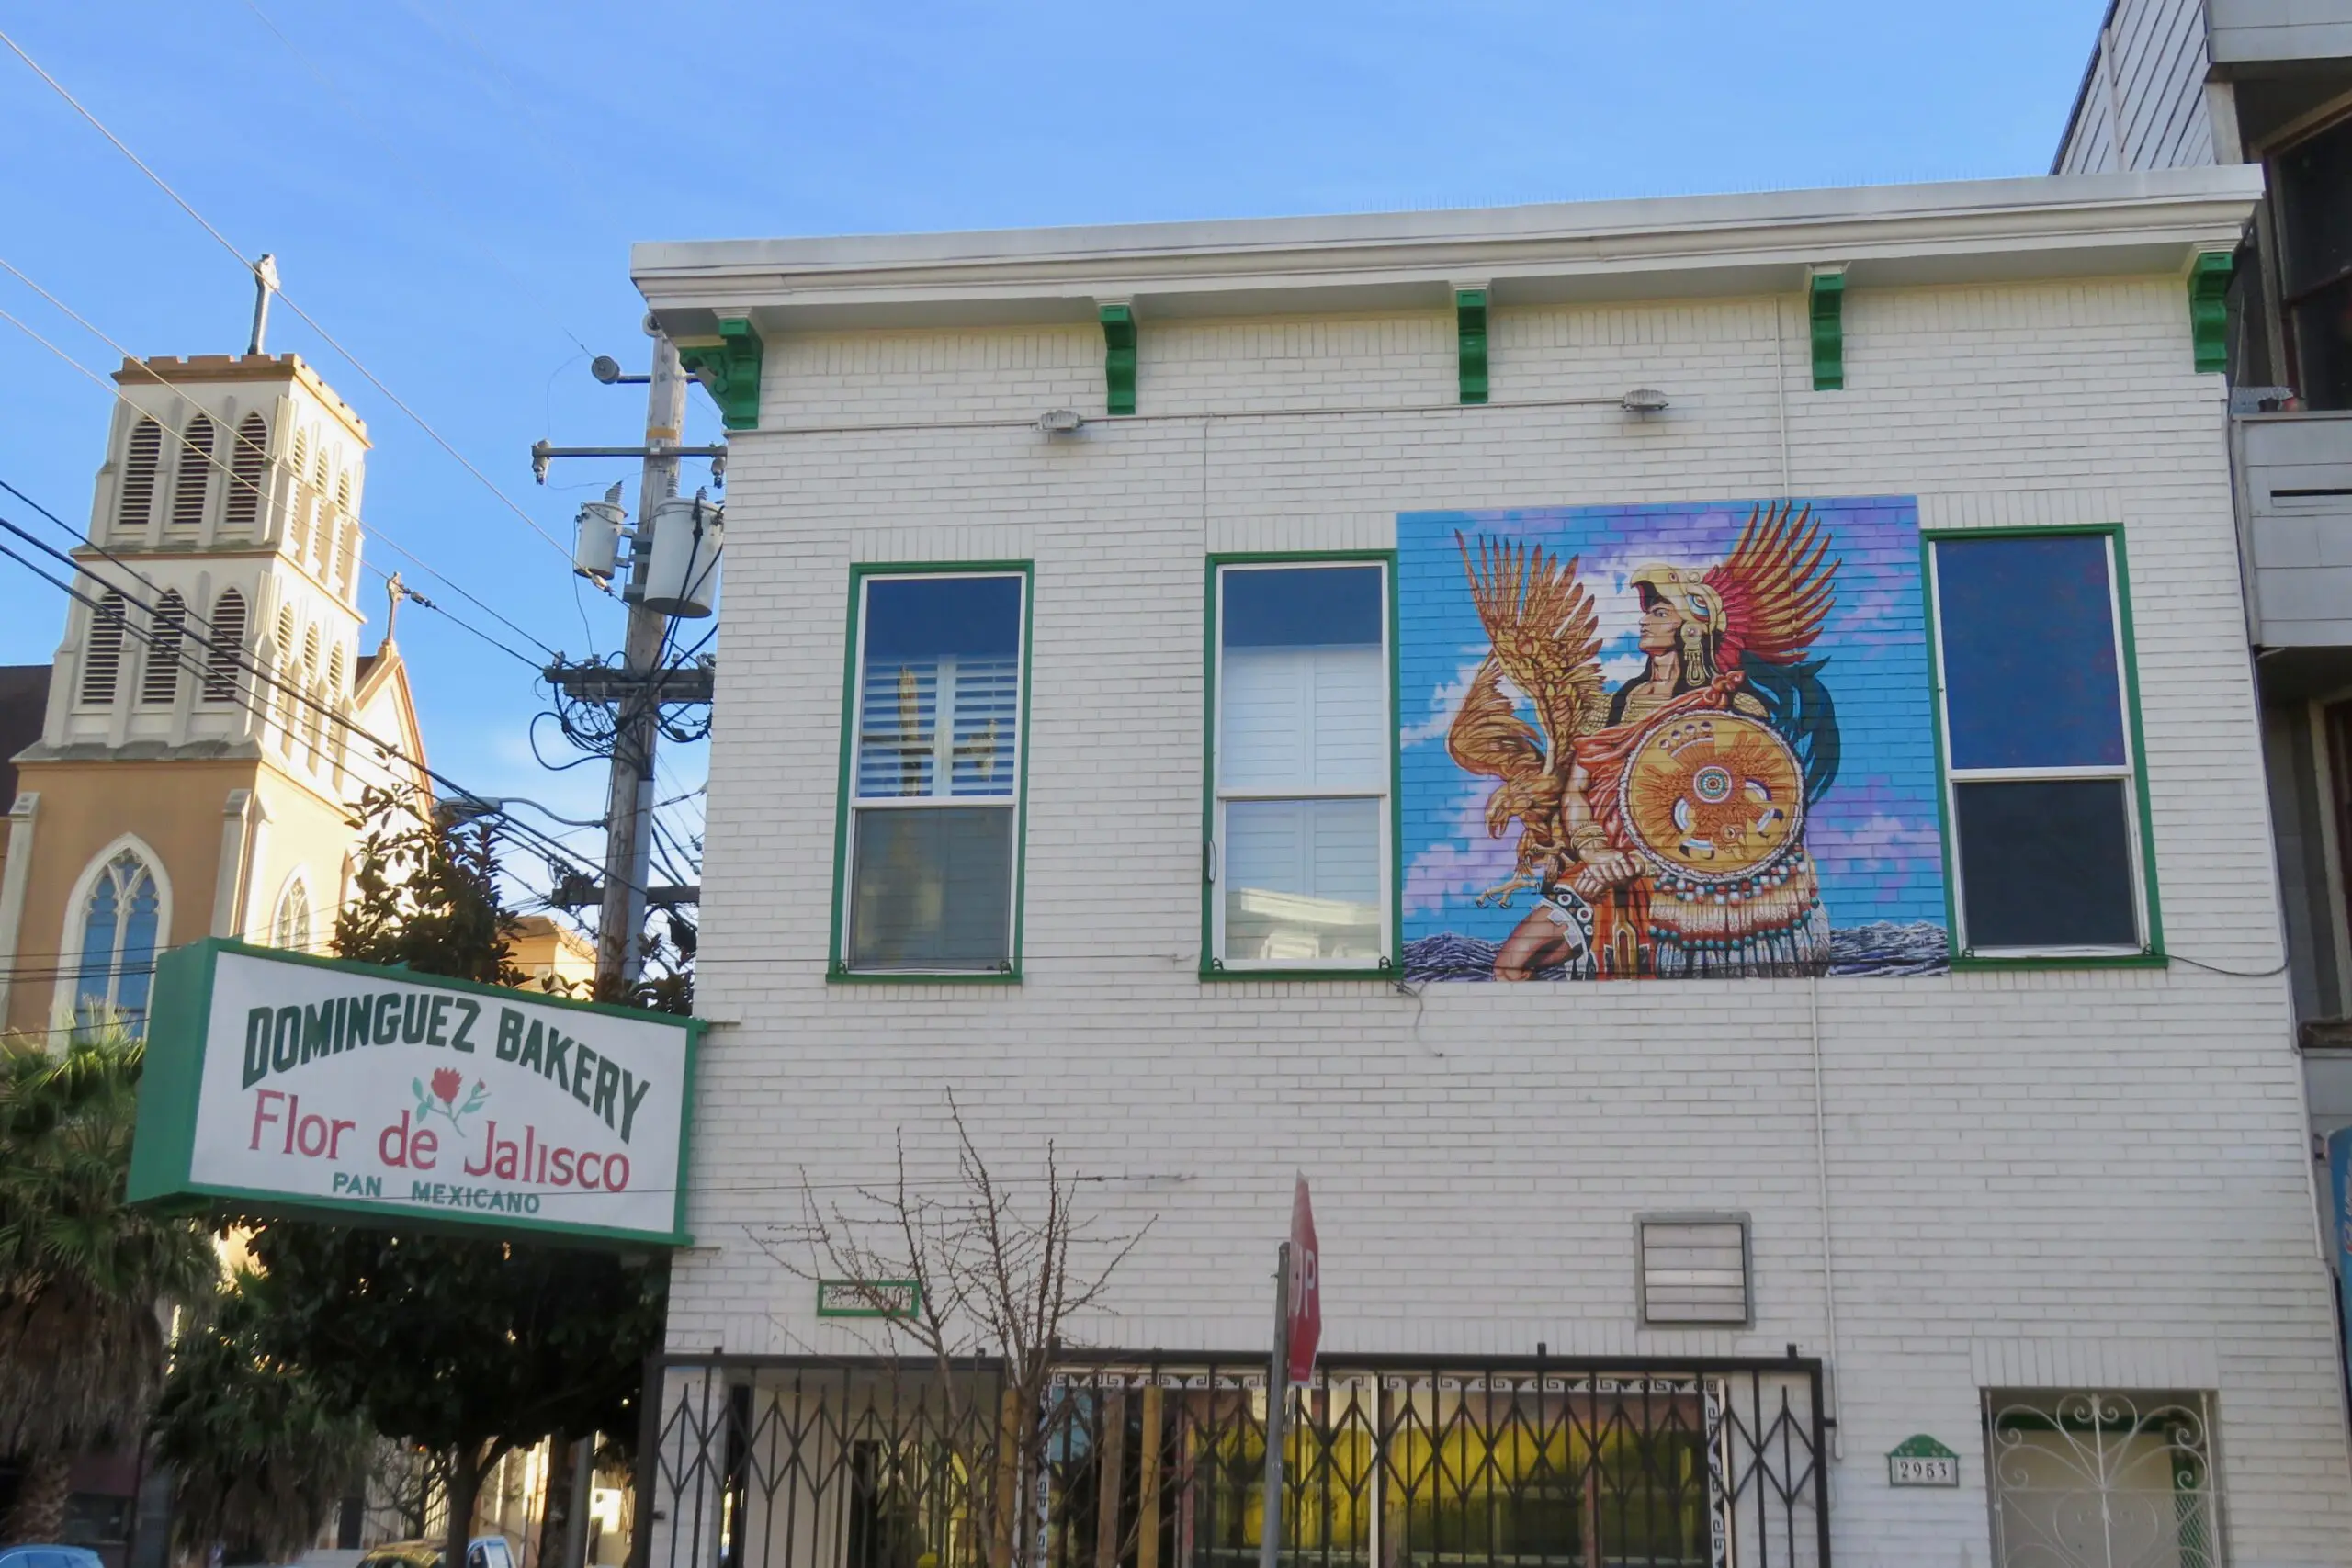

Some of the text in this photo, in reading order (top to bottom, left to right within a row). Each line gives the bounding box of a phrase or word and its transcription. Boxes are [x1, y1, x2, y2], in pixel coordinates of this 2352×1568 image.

[242, 992, 650, 1145] DOMINGUEZ BAKERY
[248, 1088, 630, 1193] Flor de Jalisco
[332, 1171, 540, 1214] PAN MEXICANO
